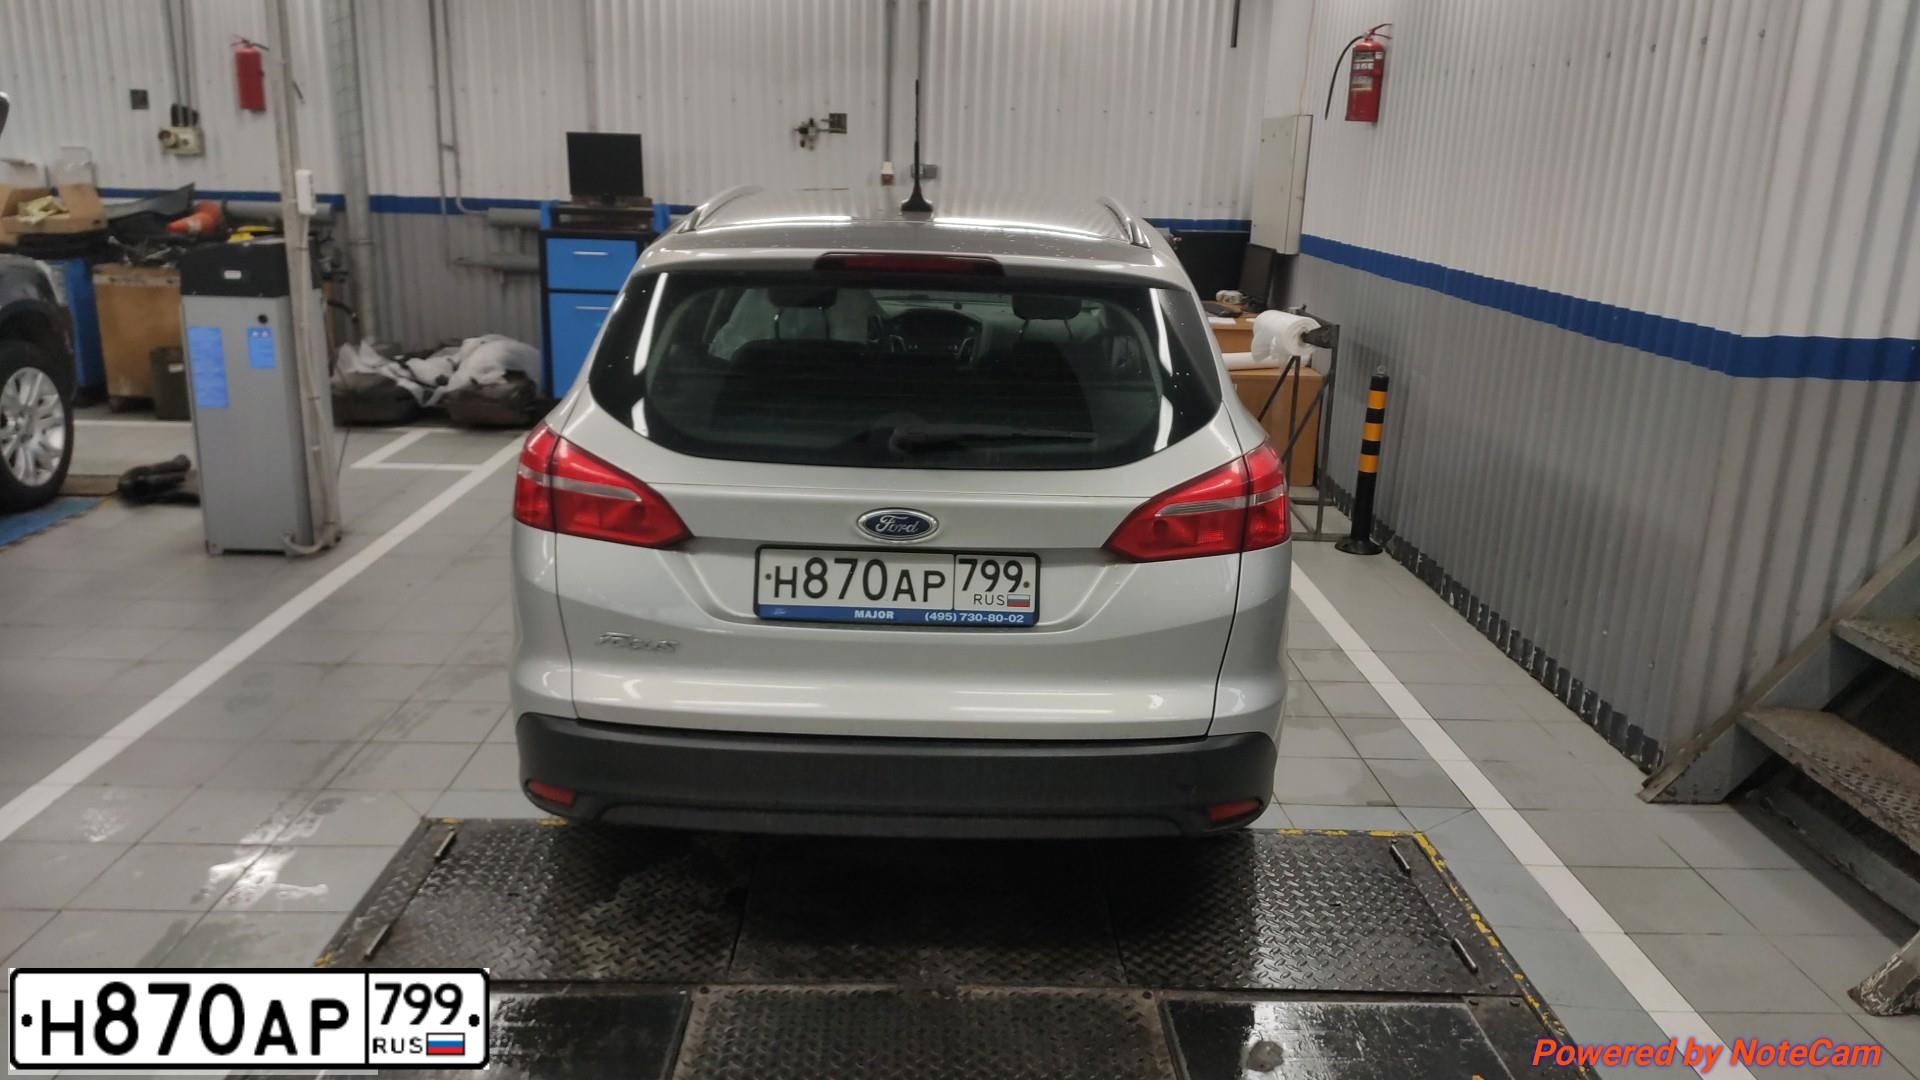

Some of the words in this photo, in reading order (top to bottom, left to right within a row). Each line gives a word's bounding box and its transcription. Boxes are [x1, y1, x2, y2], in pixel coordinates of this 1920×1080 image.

[875, 515, 920, 533] Ford
[958, 558, 1023, 593] 799
[973, 593, 1005, 606] RUS
[854, 609, 895, 620] MAJOR
[924, 611, 957, 623] (495)
[959, 613, 1024, 624] 730-80-02
